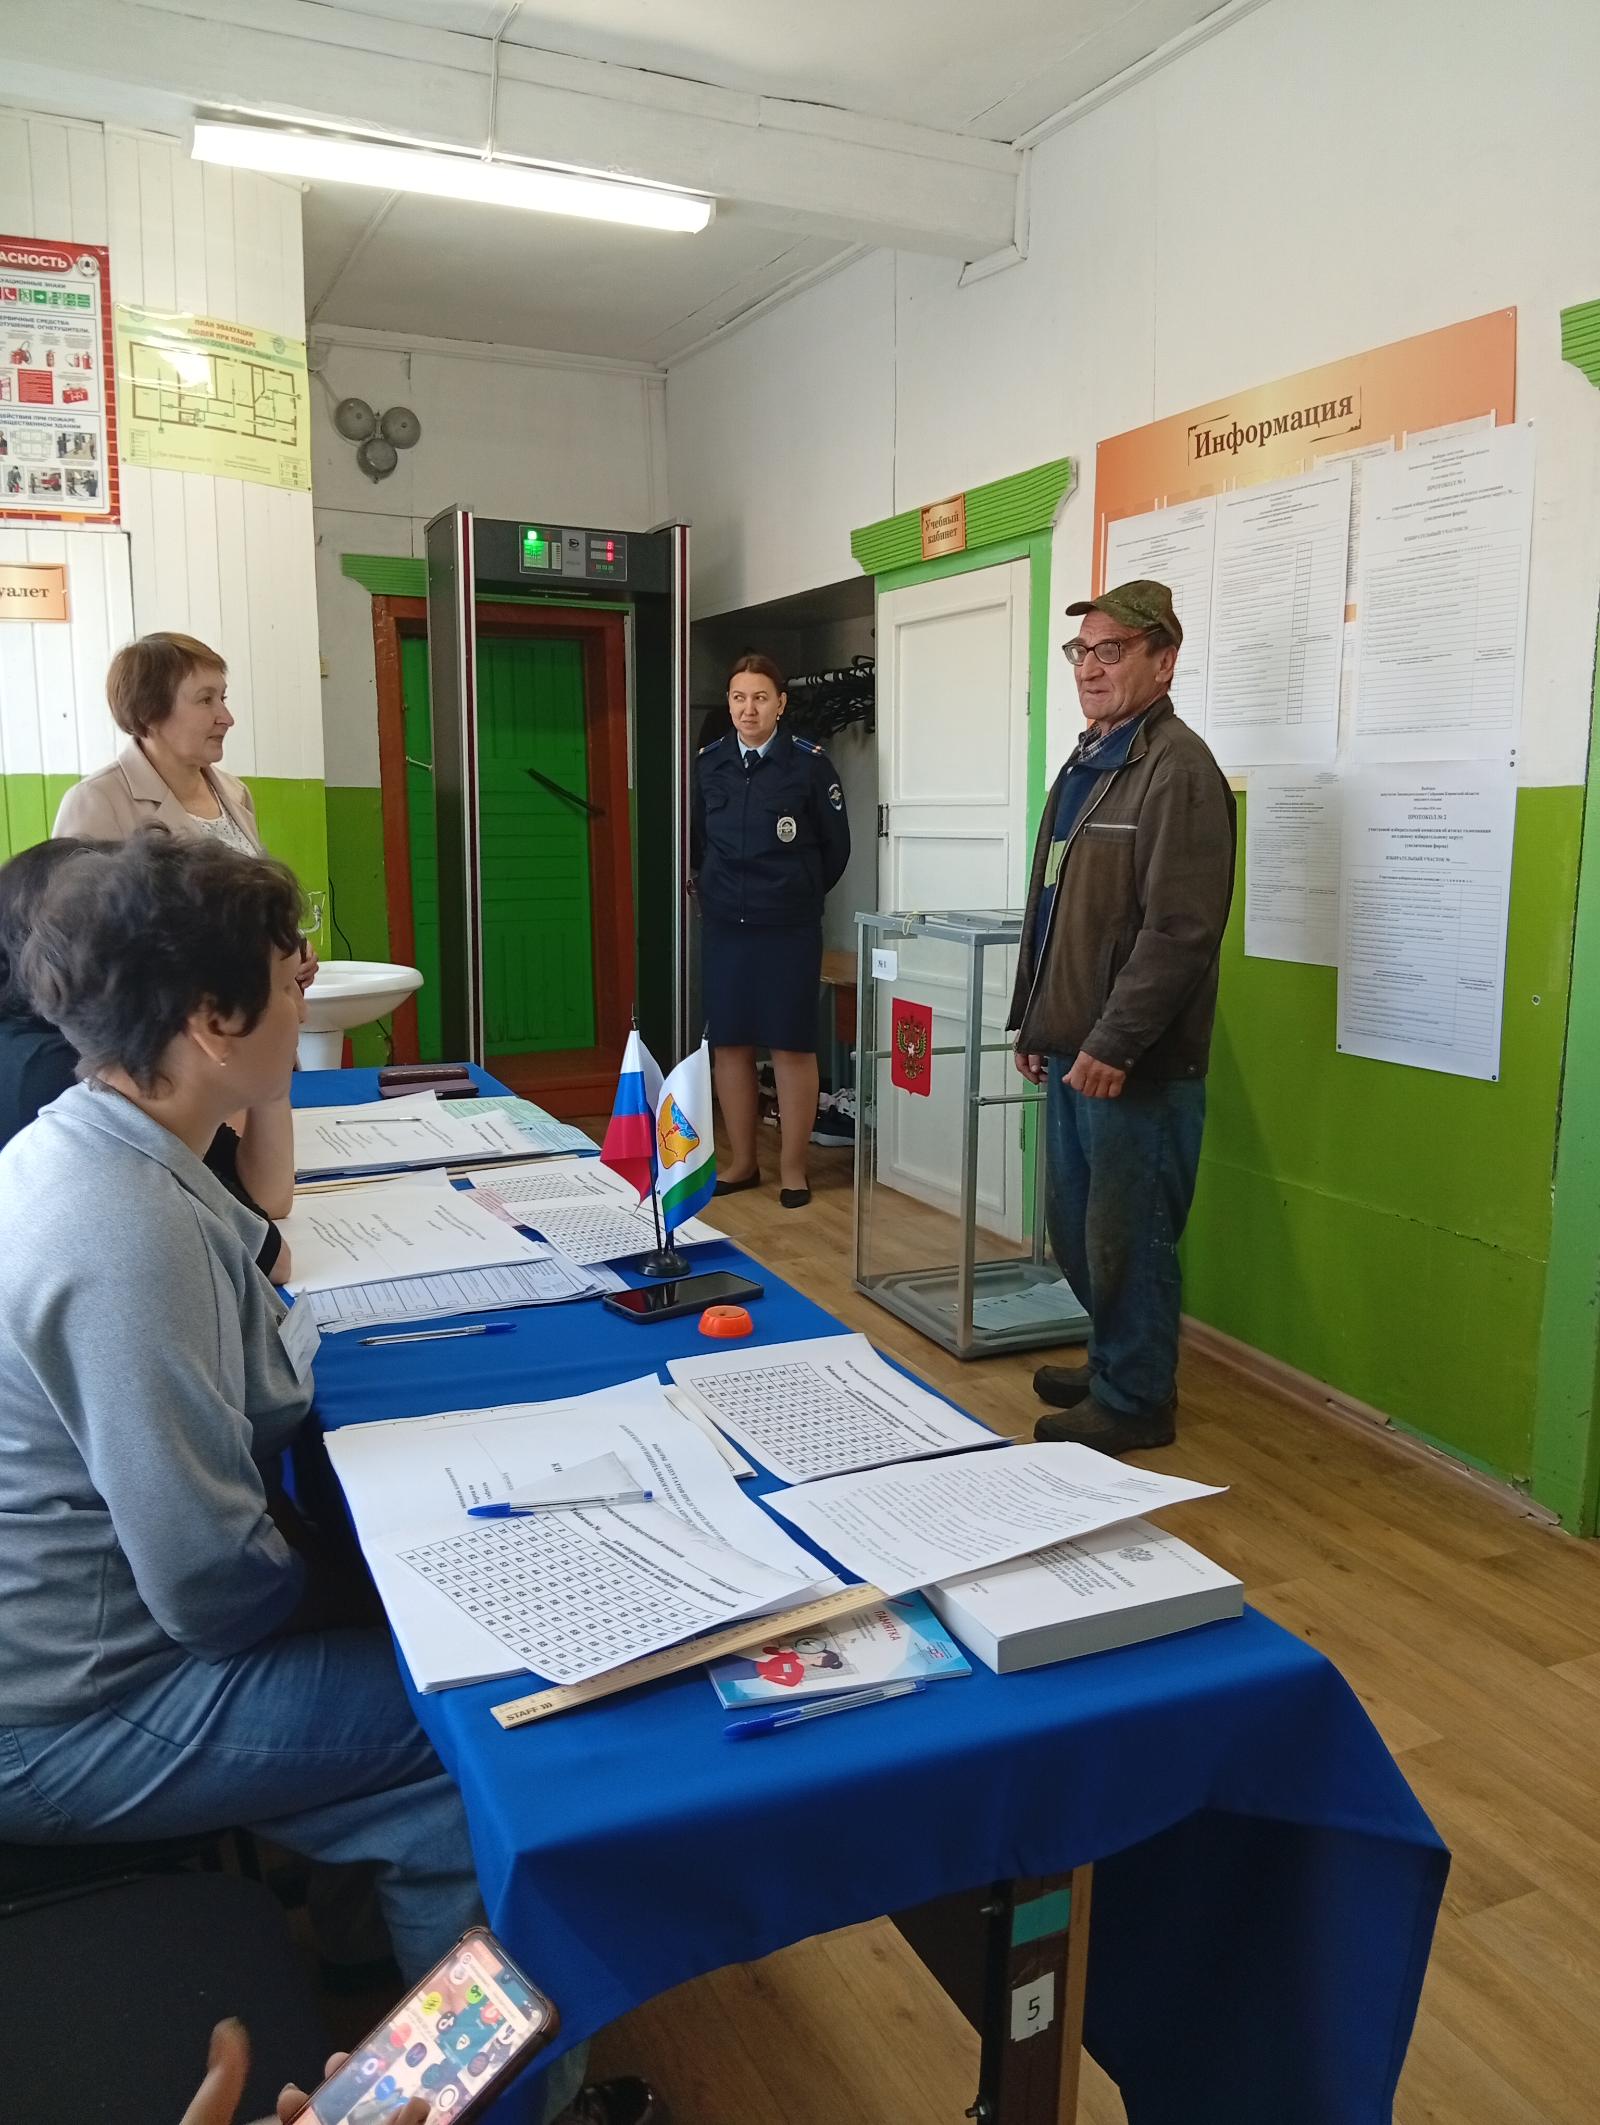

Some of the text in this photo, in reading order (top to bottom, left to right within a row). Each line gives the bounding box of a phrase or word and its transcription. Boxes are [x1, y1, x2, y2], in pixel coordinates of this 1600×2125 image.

[1194, 395, 1354, 461] Информация
[925, 511, 959, 532] Учебный
[927, 528, 958, 545] кабинет
[1111, 1570, 1136, 1588] ЗАКОН
[874, 1609, 902, 1641] ПАМЯТКА
[506, 1706, 539, 1721] STAFF
[1027, 1996, 1041, 2021] 5
